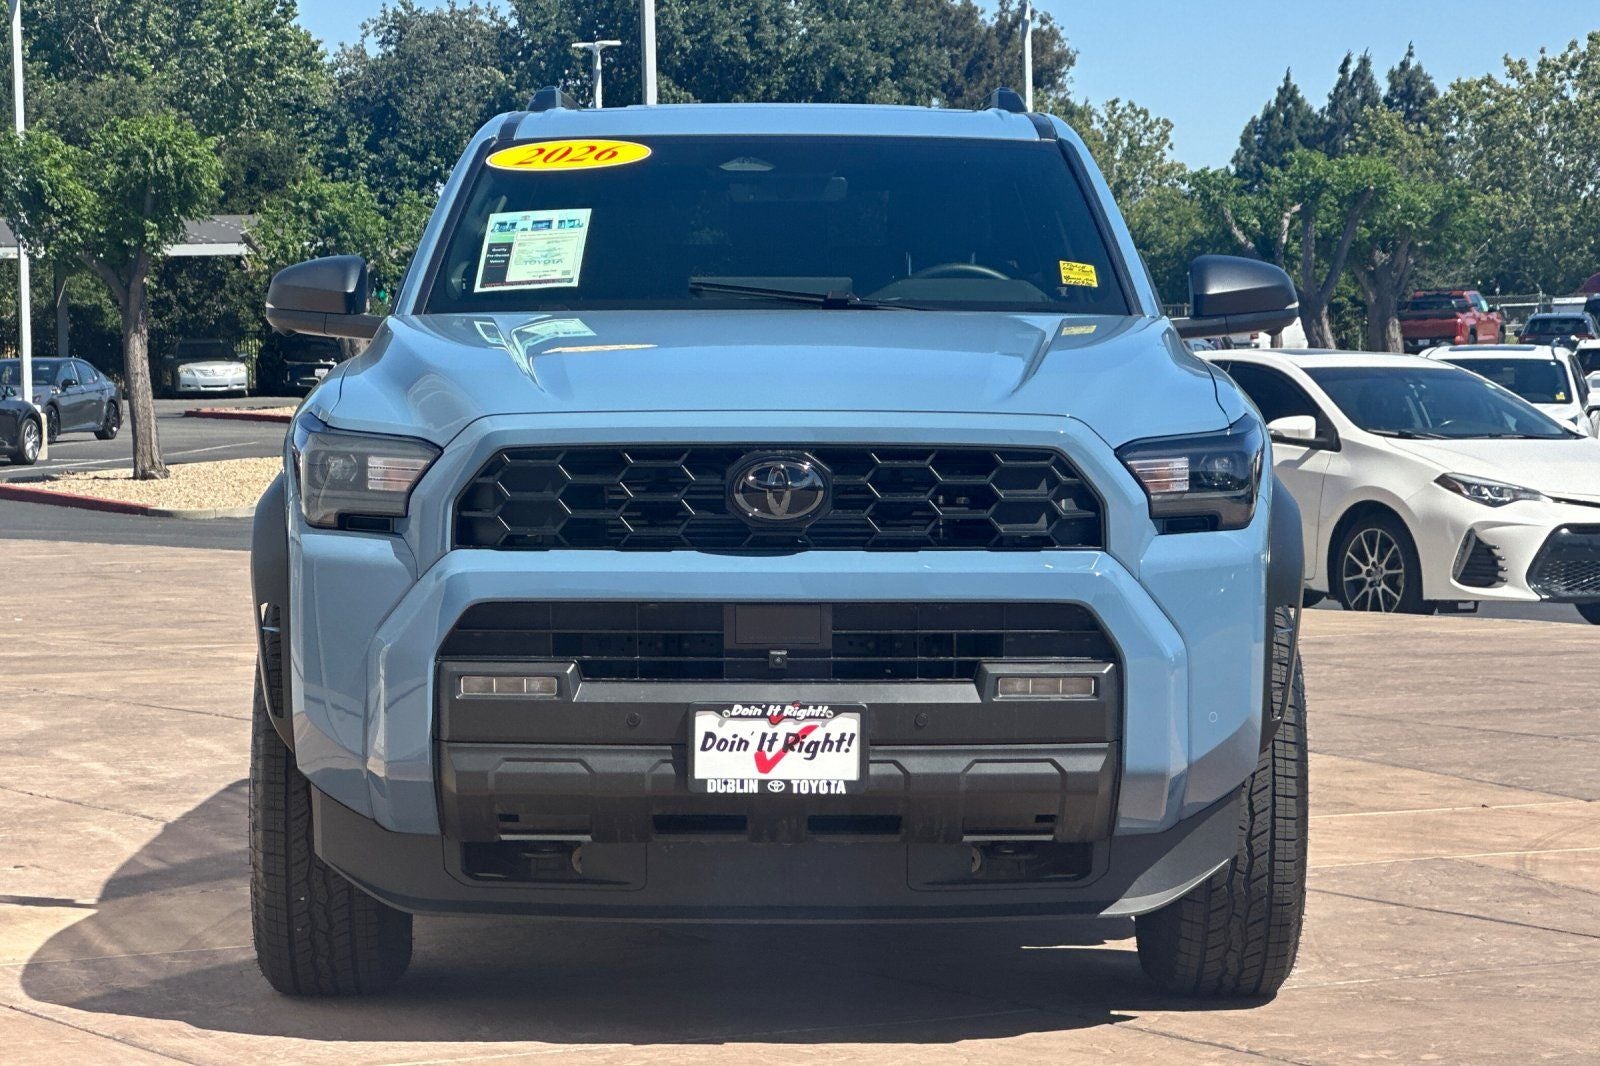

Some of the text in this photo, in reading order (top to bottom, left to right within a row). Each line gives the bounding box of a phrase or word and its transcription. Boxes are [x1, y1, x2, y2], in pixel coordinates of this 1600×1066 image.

[513, 145, 625, 166] 2026
[730, 704, 828, 720] Doin' It Right!
[700, 731, 856, 761] Doin' It Right!
[707, 779, 846, 795] DUBLIN TOYOTA
